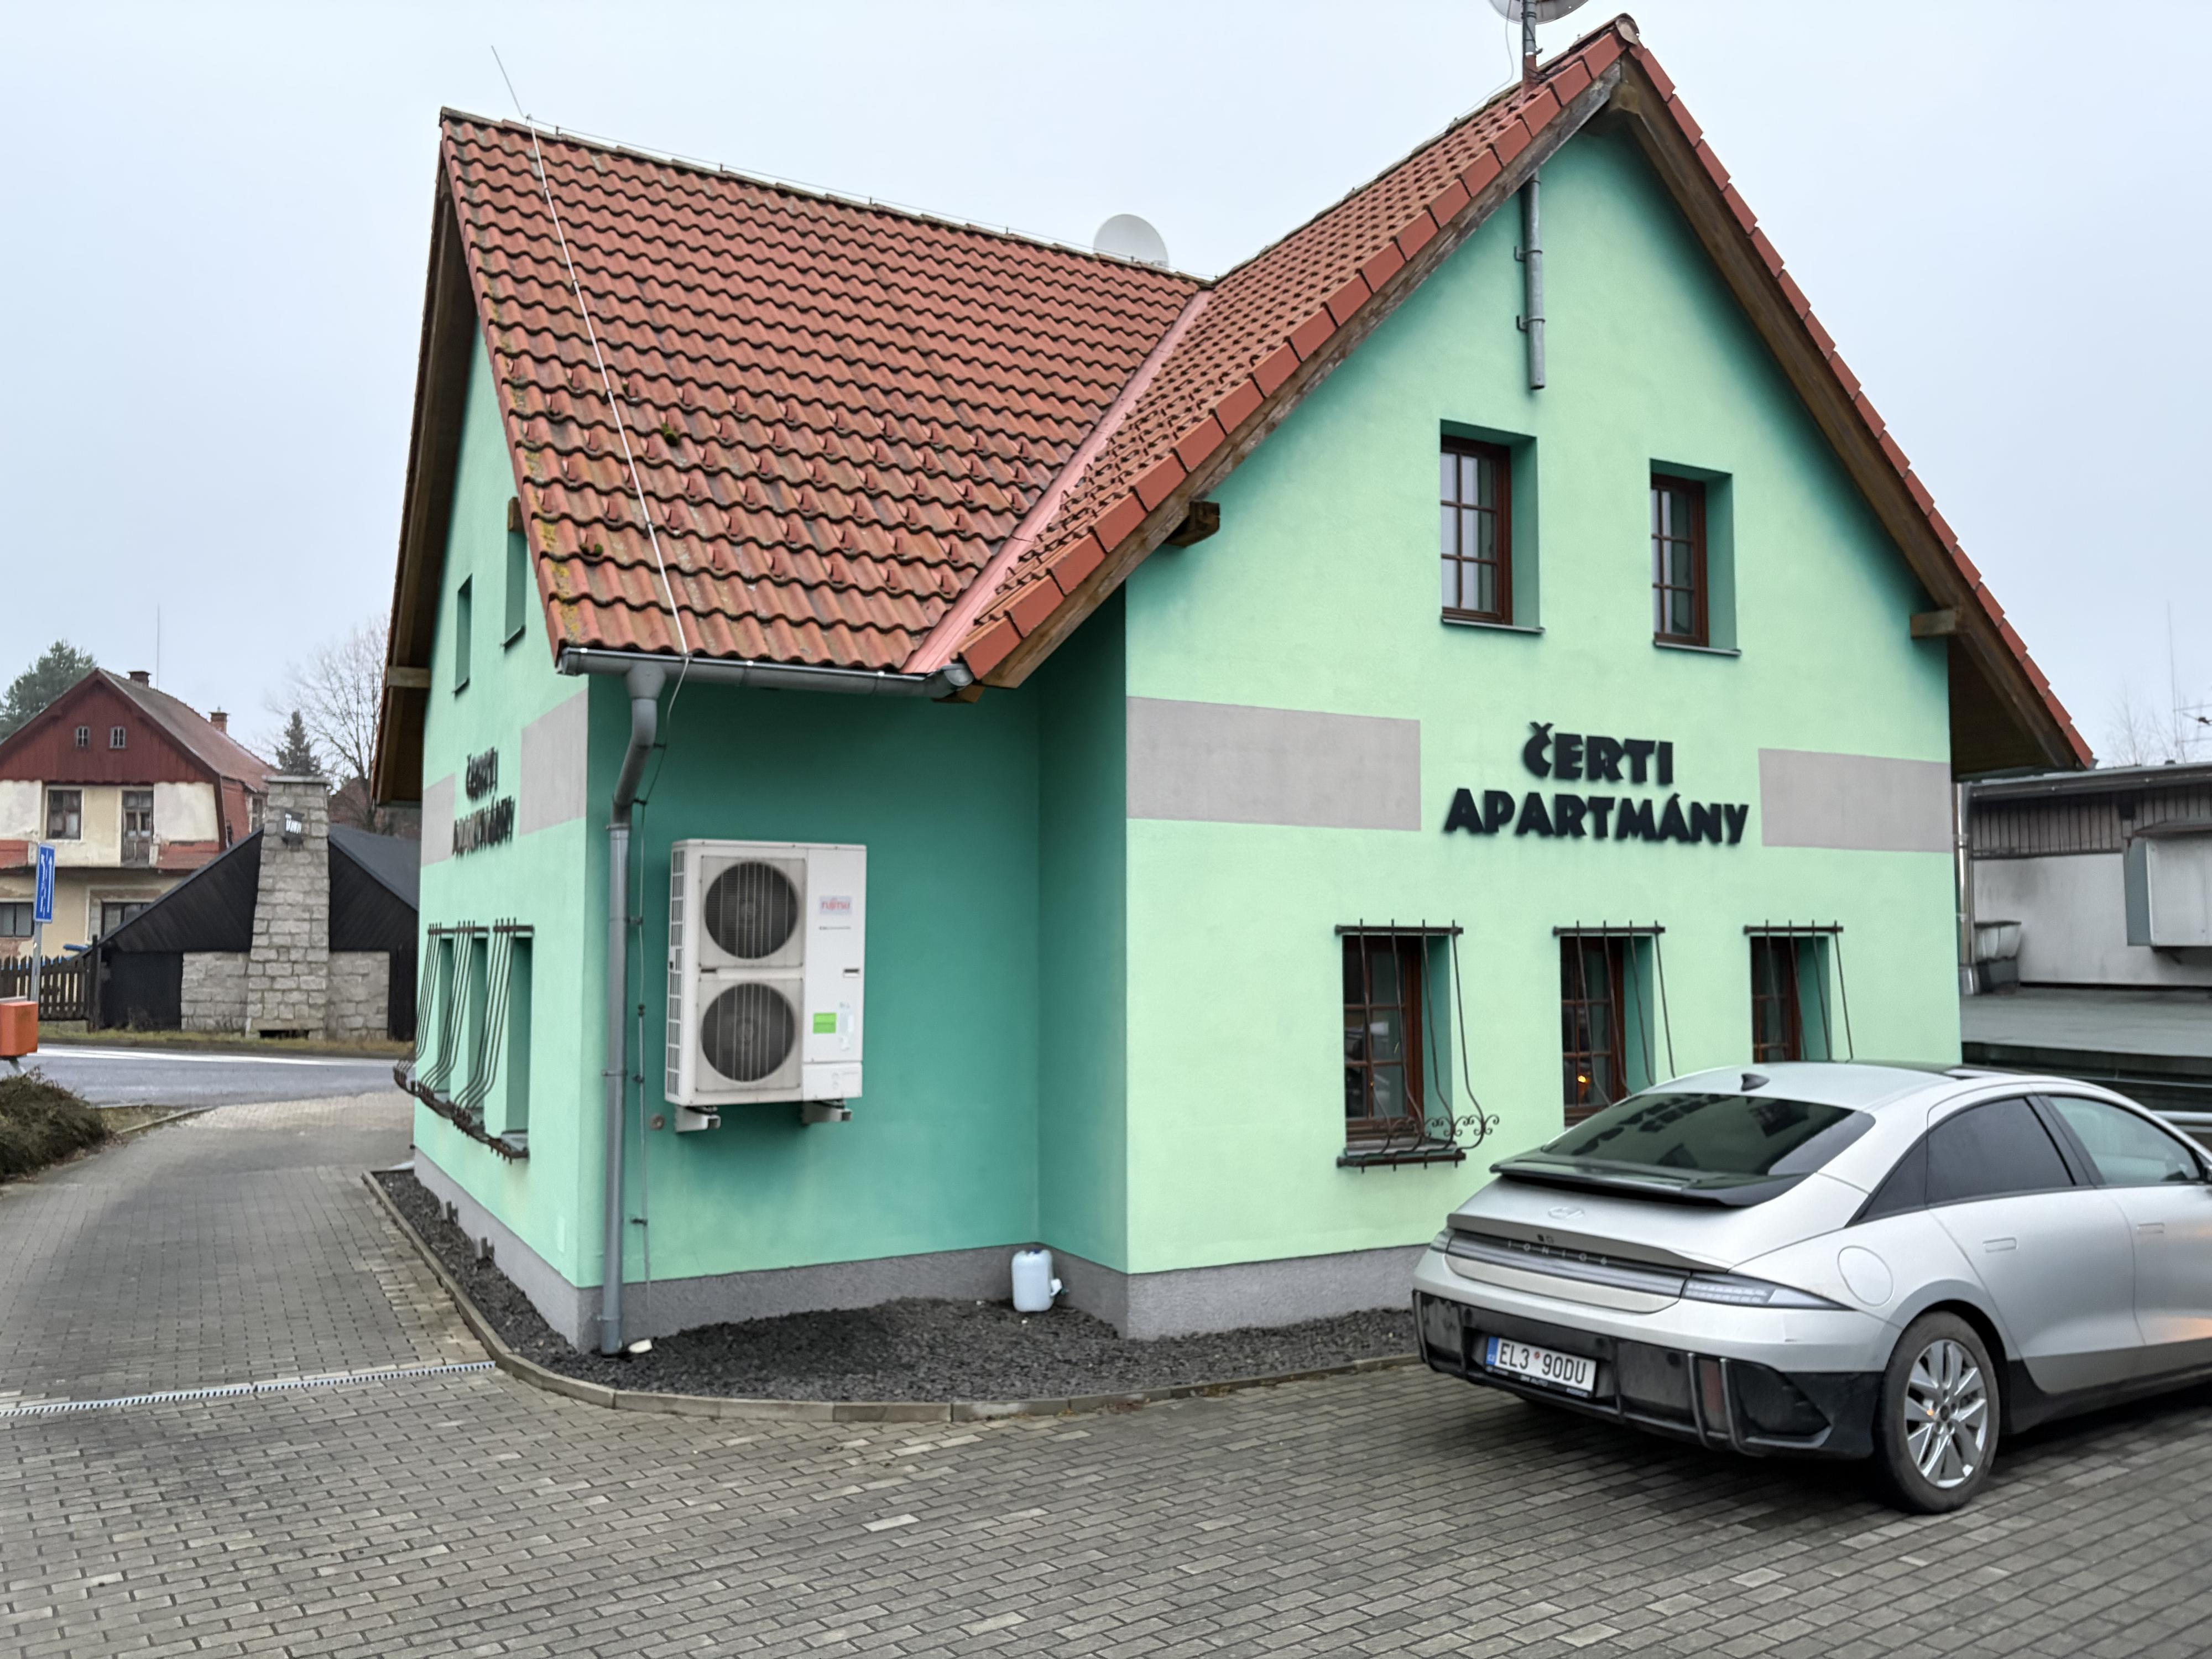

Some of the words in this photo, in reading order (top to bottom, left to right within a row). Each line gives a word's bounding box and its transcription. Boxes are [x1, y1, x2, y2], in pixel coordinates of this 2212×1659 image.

[1523, 721, 1673, 785] ČERTI
[1442, 788, 1749, 844] APARTMÁNY
[1499, 1342, 1530, 1370] EL3
[1541, 1353, 1587, 1384] 90DU
